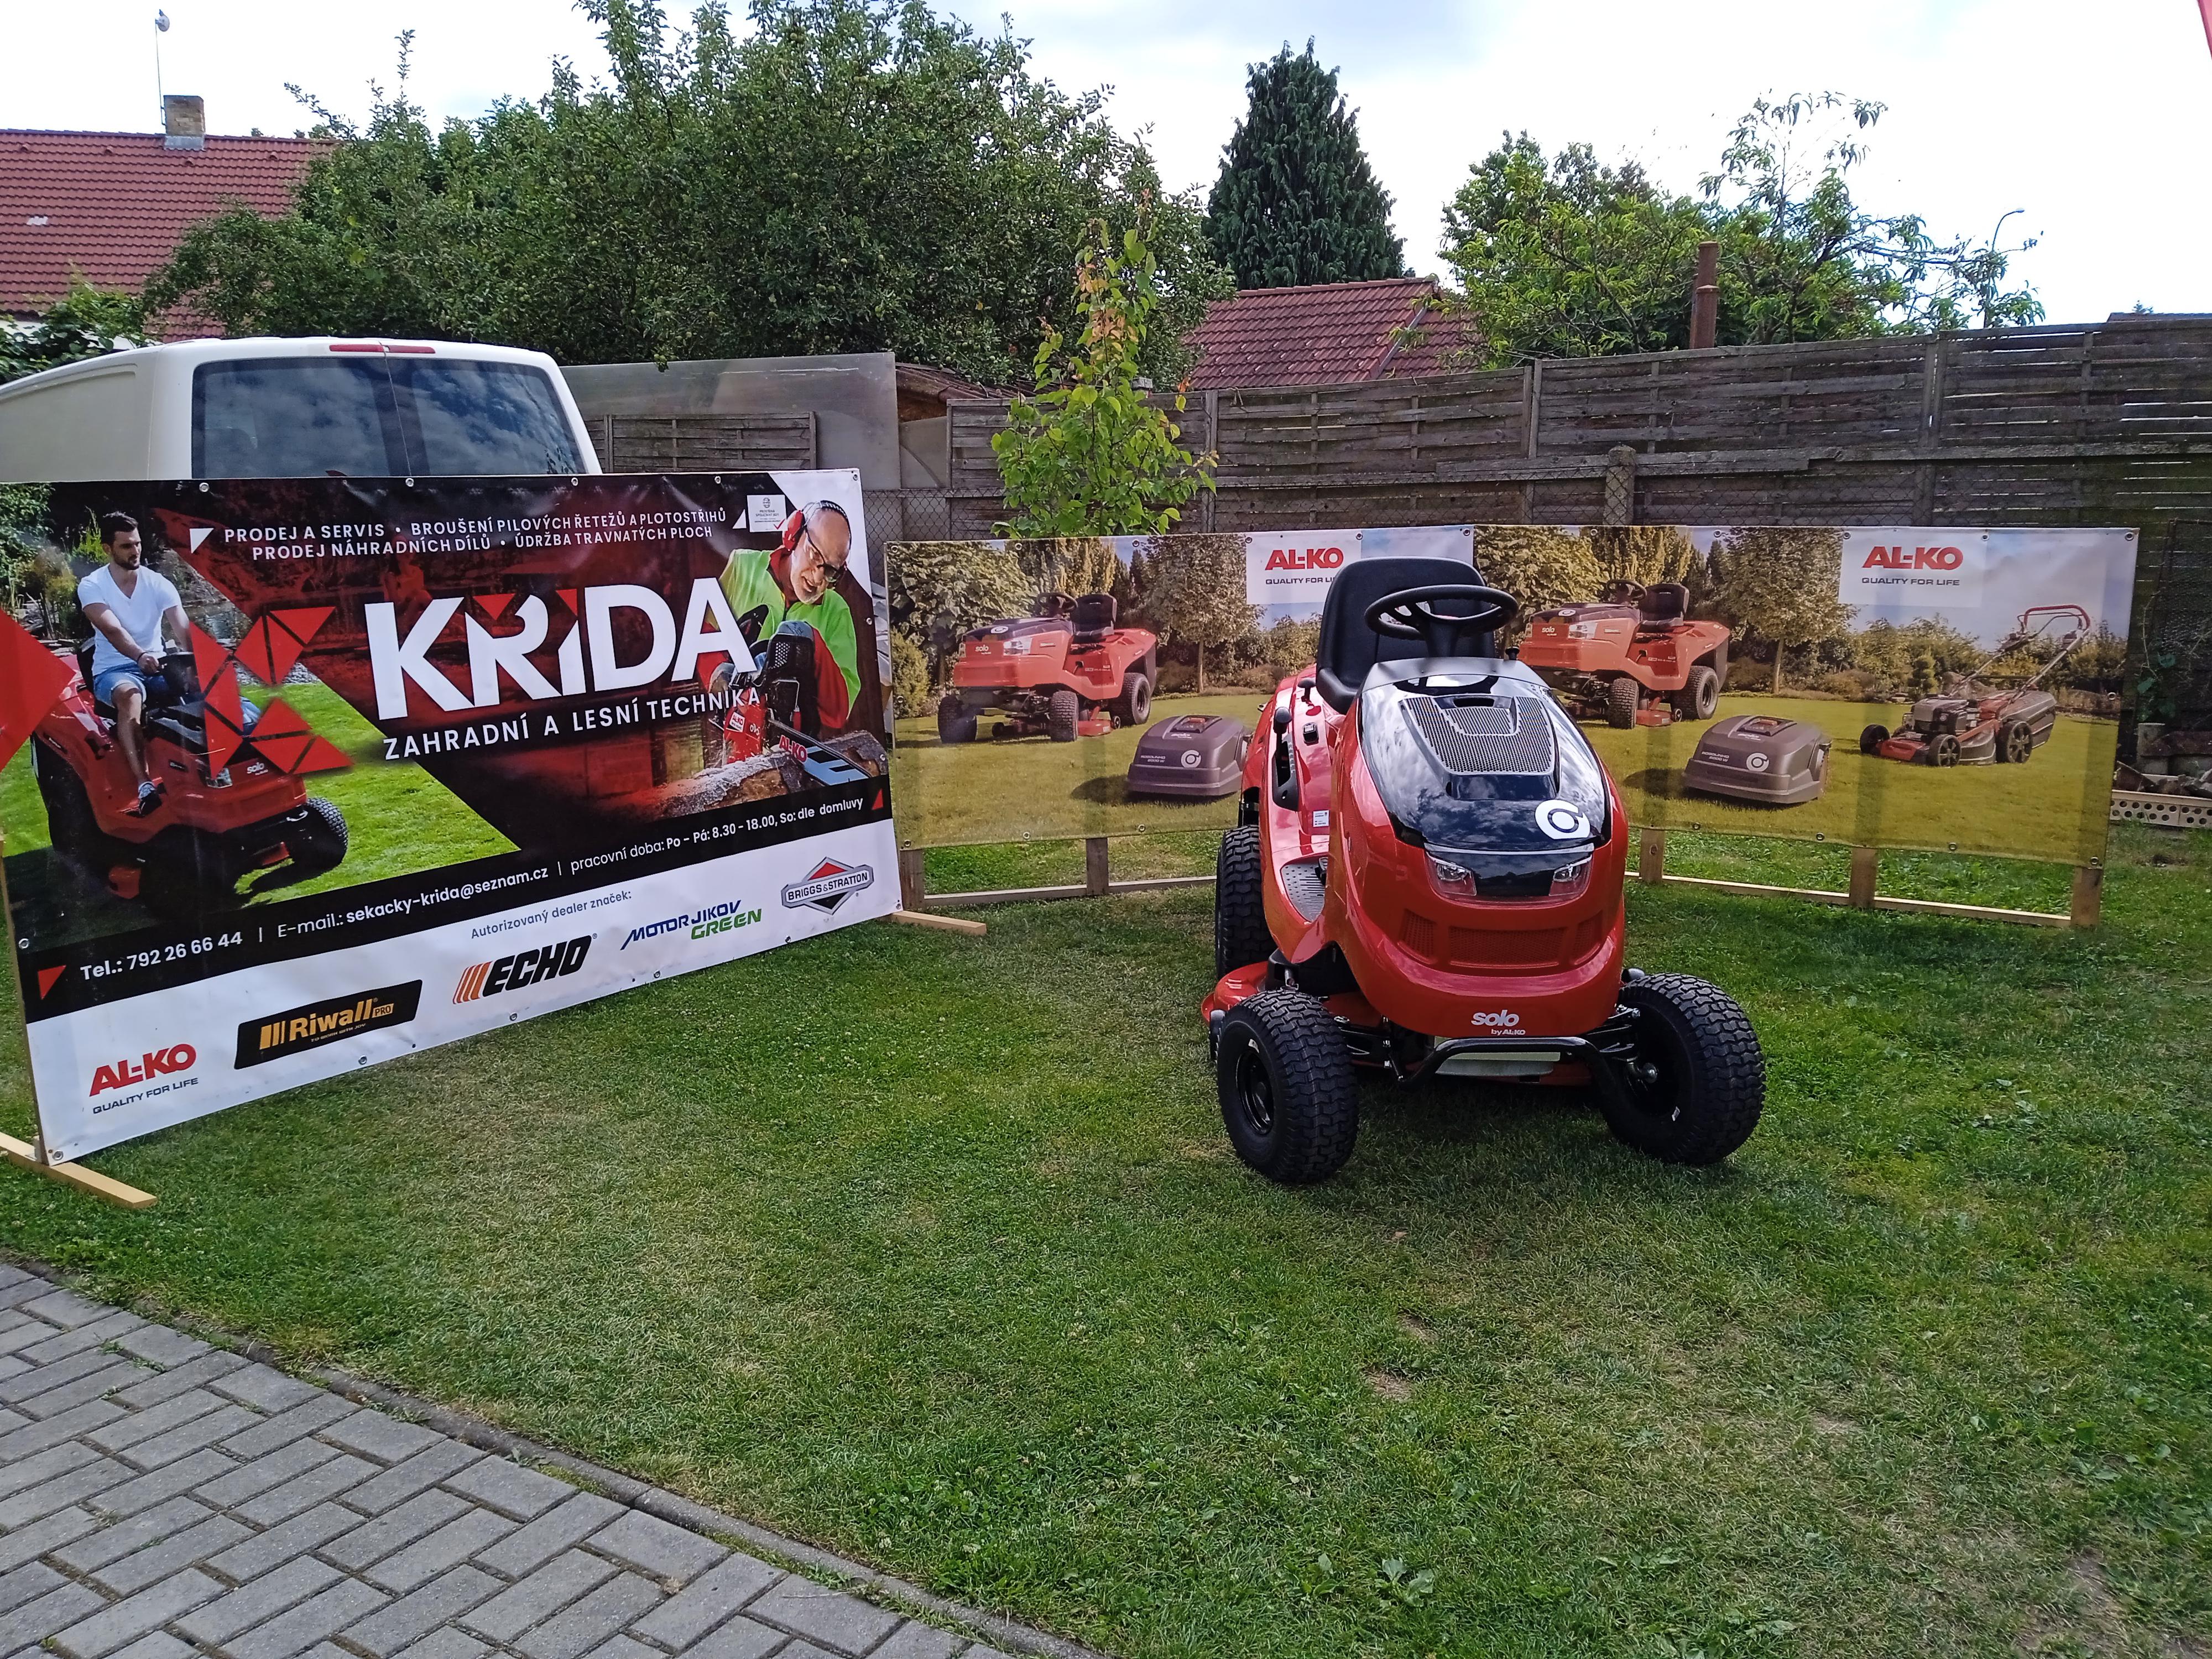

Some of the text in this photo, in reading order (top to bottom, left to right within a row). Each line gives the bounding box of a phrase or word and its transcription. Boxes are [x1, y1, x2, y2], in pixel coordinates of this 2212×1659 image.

[225, 527, 297, 542] PRODEJ
[304, 526, 315, 540] A
[321, 524, 384, 539] SERVIS
[411, 517, 494, 536] BROUŠENÍ
[498, 514, 571, 532] PILOVÝCH
[629, 513, 638, 526] A
[640, 507, 726, 526] PLOTOSTŘIHŮ
[253, 526, 712, 561] PRODEJ NÁHRADNÍCH DÍLŮ ÚDRŽBA TRAVNATÝCH PLOCH
[1265, 547, 1344, 571] AL-KO
[1862, 546, 1963, 570] AL-KO
[384, 687, 760, 760] ZAHRADNÍ A LESNÍ TECHNIKA
[81, 959, 123, 980] Tel.:
[127, 951, 160, 970] 792
[165, 944, 187, 961] 26
[191, 938, 214, 955] 66
[218, 931, 243, 948] 44
[278, 912, 343, 937] E-mail.:
[347, 867, 549, 924] sekacky-krida@seznam.cz
[571, 847, 627, 875] pracovní
[630, 841, 665, 858] doba:
[667, 837, 681, 849] Po
[693, 828, 711, 844] Pá:
[712, 823, 736, 838] 8.30
[746, 815, 778, 831] 18.00,
[780, 811, 796, 823] So:
[798, 806, 815, 820] dle
[820, 797, 863, 816] domluvy
[471, 890, 632, 939] Autorizovaný dealer značek:
[620, 900, 742, 950] MOTOR JIKOV
[691, 909, 762, 940] GREEN
[482, 935, 592, 997] ECHO
[289, 999, 391, 1041] Riwall PRO
[1471, 1009, 1520, 1026] solo
[89, 1044, 197, 1097] AL-KO
[92, 1077, 199, 1114] QUALITY FOR LIFE
